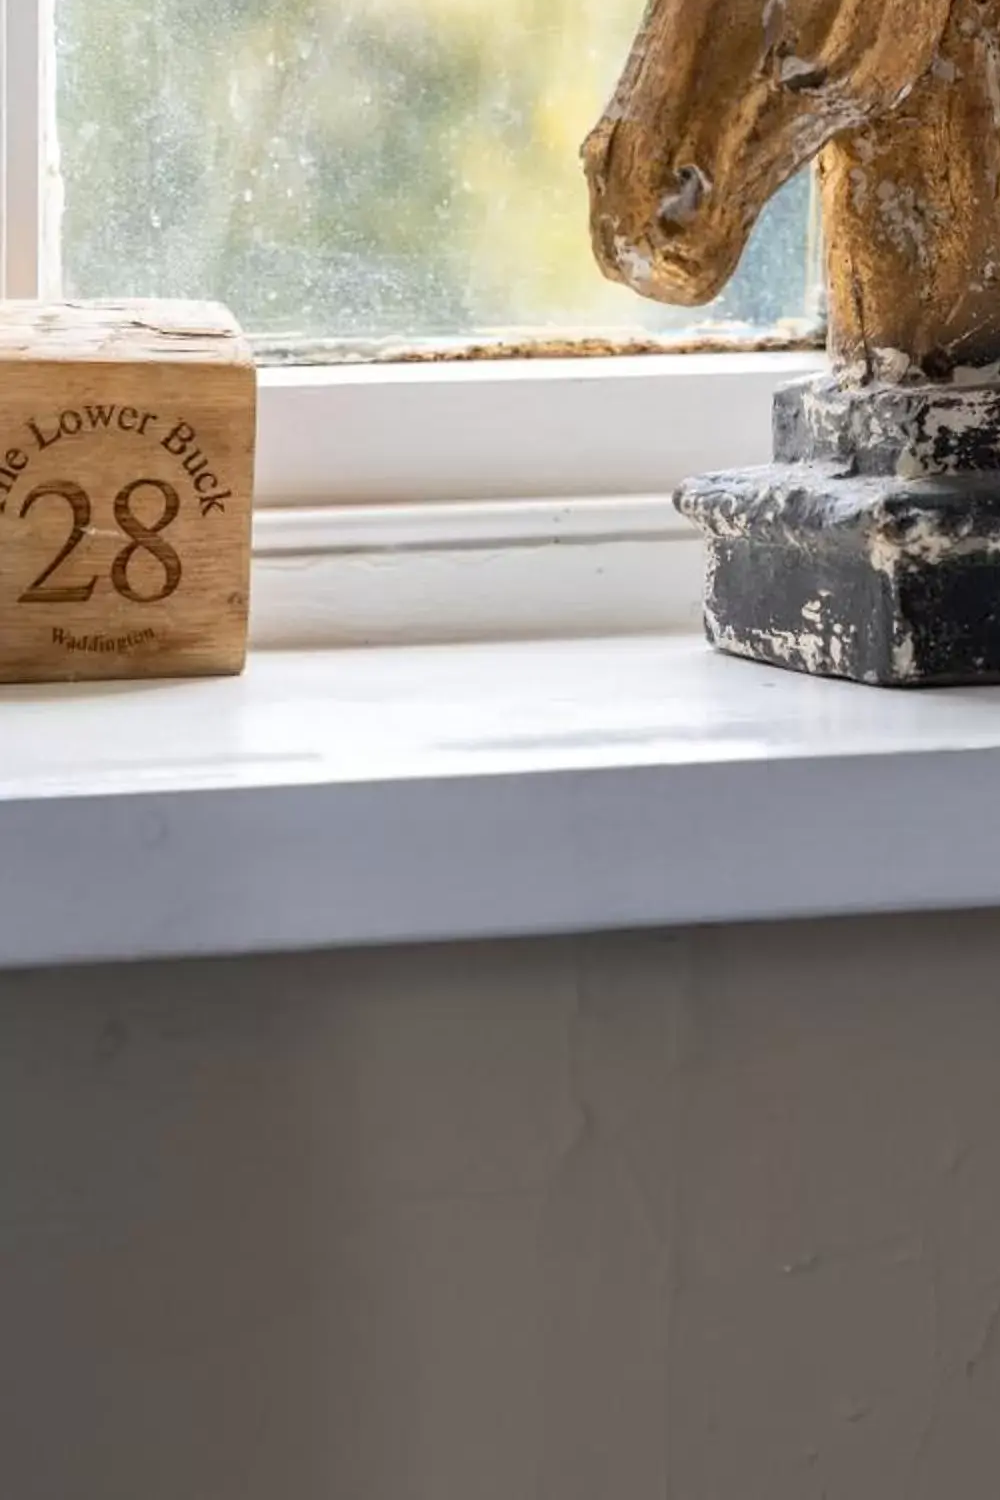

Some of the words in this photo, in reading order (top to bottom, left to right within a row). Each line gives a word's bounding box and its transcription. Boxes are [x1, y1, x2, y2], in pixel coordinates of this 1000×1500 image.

[25, 404, 158, 451] Lower
[160, 416, 232, 517] Buck
[17, 477, 183, 603] 28
